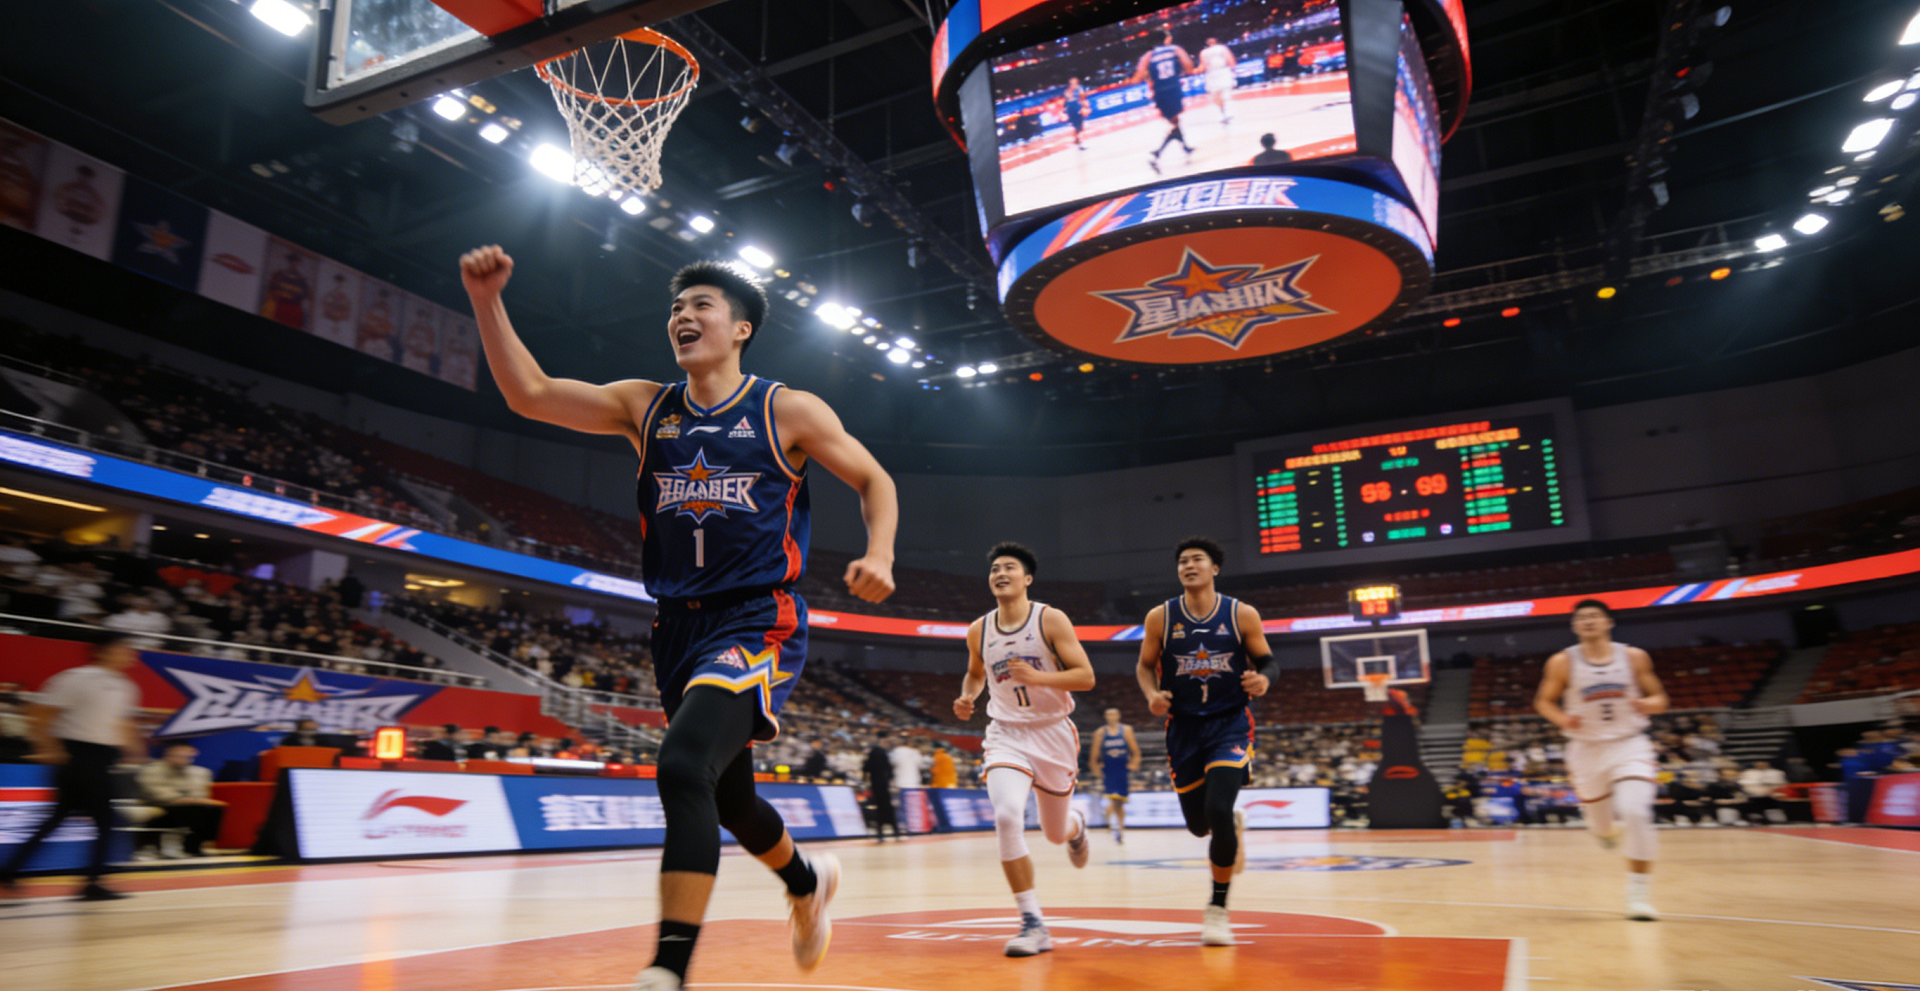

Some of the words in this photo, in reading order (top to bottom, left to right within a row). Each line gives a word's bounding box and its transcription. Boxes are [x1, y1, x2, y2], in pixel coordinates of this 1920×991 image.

[692, 528, 704, 568] 1
[1013, 686, 1031, 706] 11
[1200, 684, 1209, 703] 1
